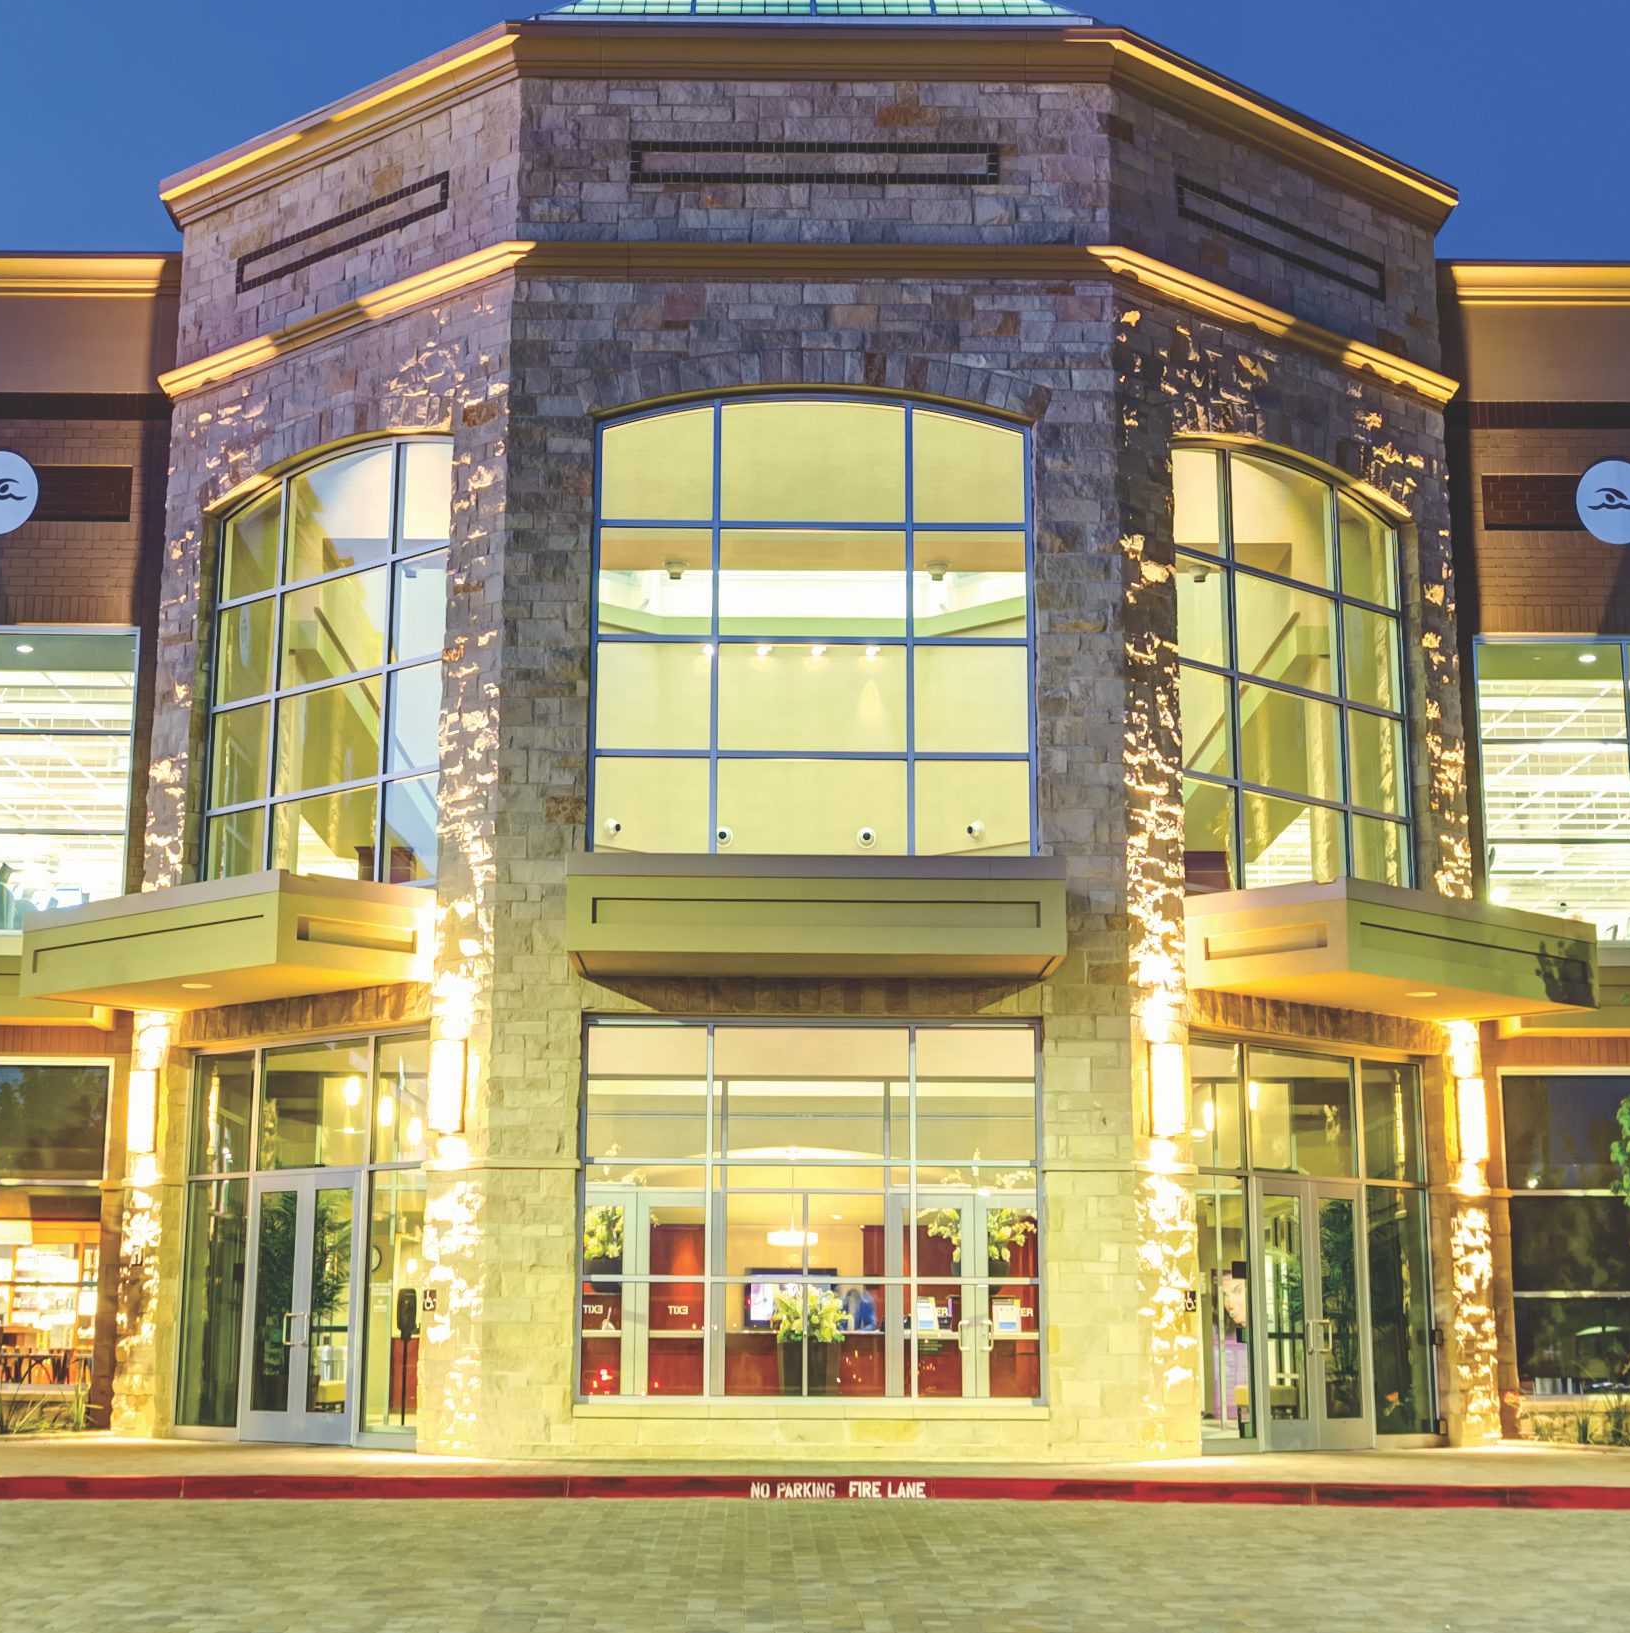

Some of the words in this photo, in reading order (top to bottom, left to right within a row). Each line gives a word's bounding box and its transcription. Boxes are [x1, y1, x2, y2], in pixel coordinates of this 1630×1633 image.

[750, 1481, 770, 1499] NO
[777, 1481, 836, 1499] PARKING
[848, 1480, 882, 1498] FIRE
[887, 1481, 927, 1499] LANE
